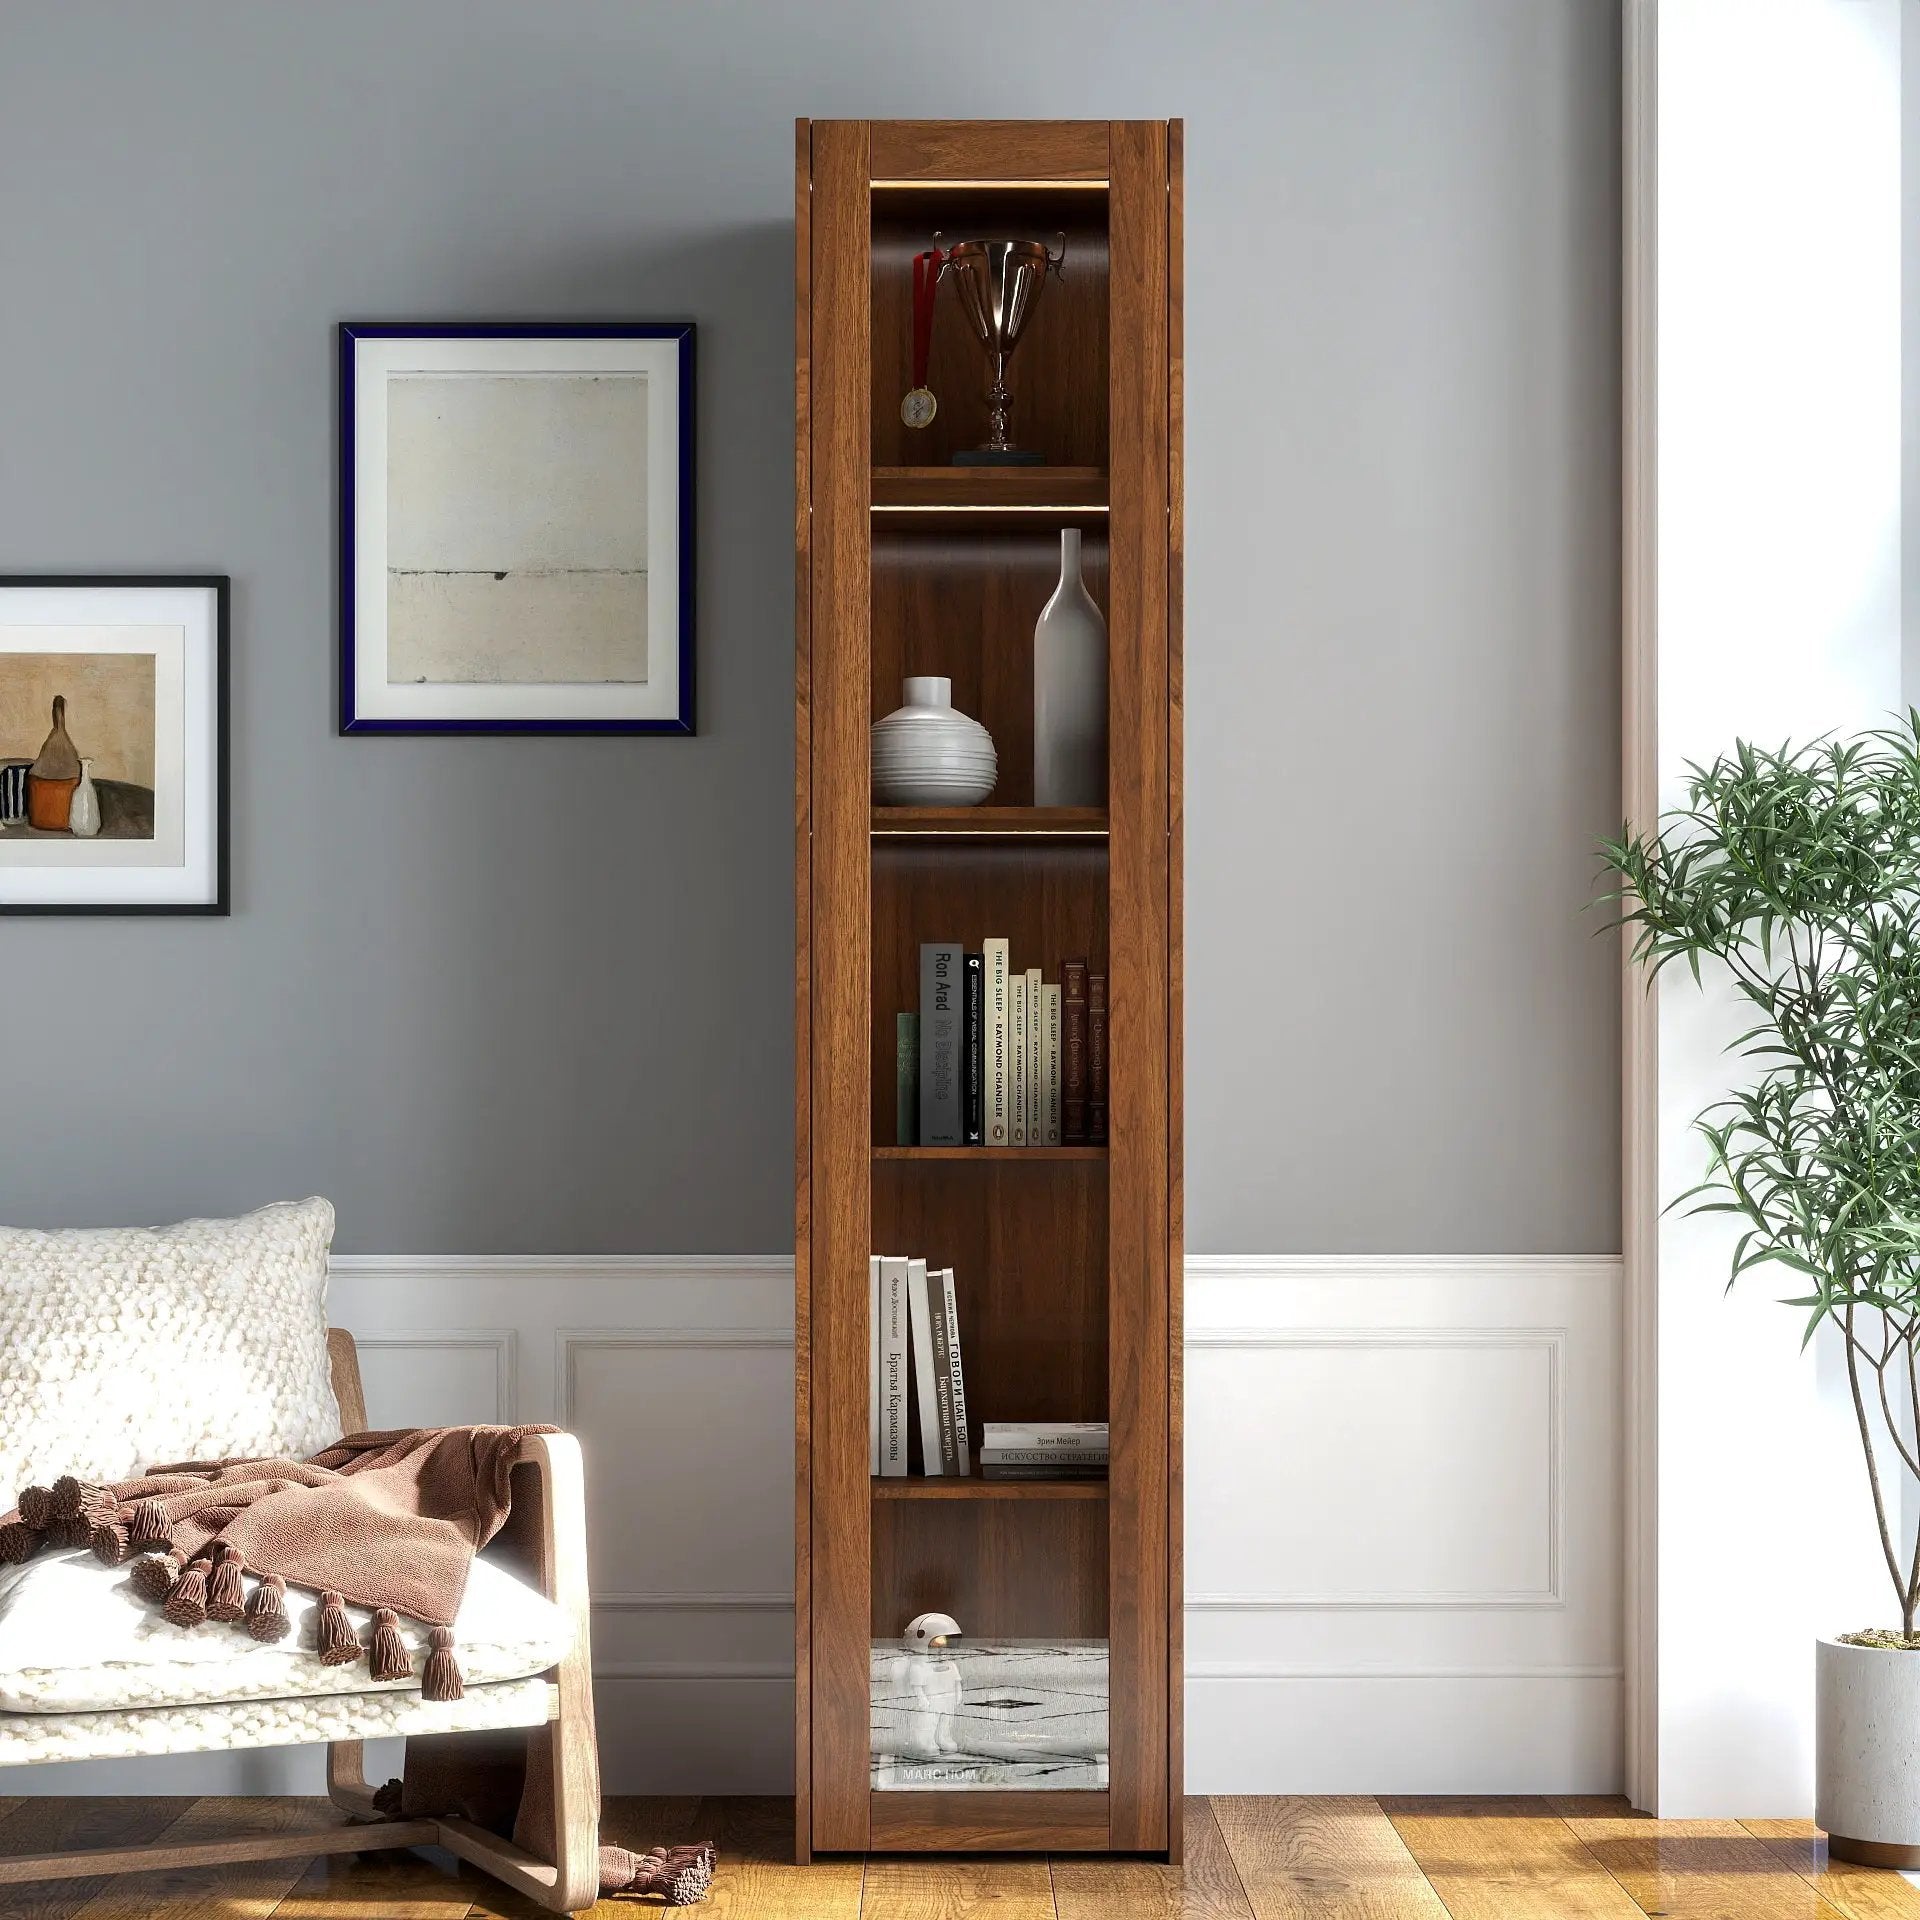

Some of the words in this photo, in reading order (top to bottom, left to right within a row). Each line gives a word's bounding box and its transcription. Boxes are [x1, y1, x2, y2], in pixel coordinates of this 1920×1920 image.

[935, 953, 950, 978] Ron
[935, 980, 951, 1011] Arad
[887, 1352, 901, 1391] Братья
[949, 1343, 962, 1396] ГОВОРИ
[955, 1400, 965, 1421] КАК
[886, 1394, 901, 1461] Карамазовы
[957, 1426, 967, 1446] БОГ
[1036, 1437, 1054, 1446] Эрин
[1056, 1436, 1081, 1446] Мейер
[1001, 1452, 1057, 1461] ИСКУССТВО
